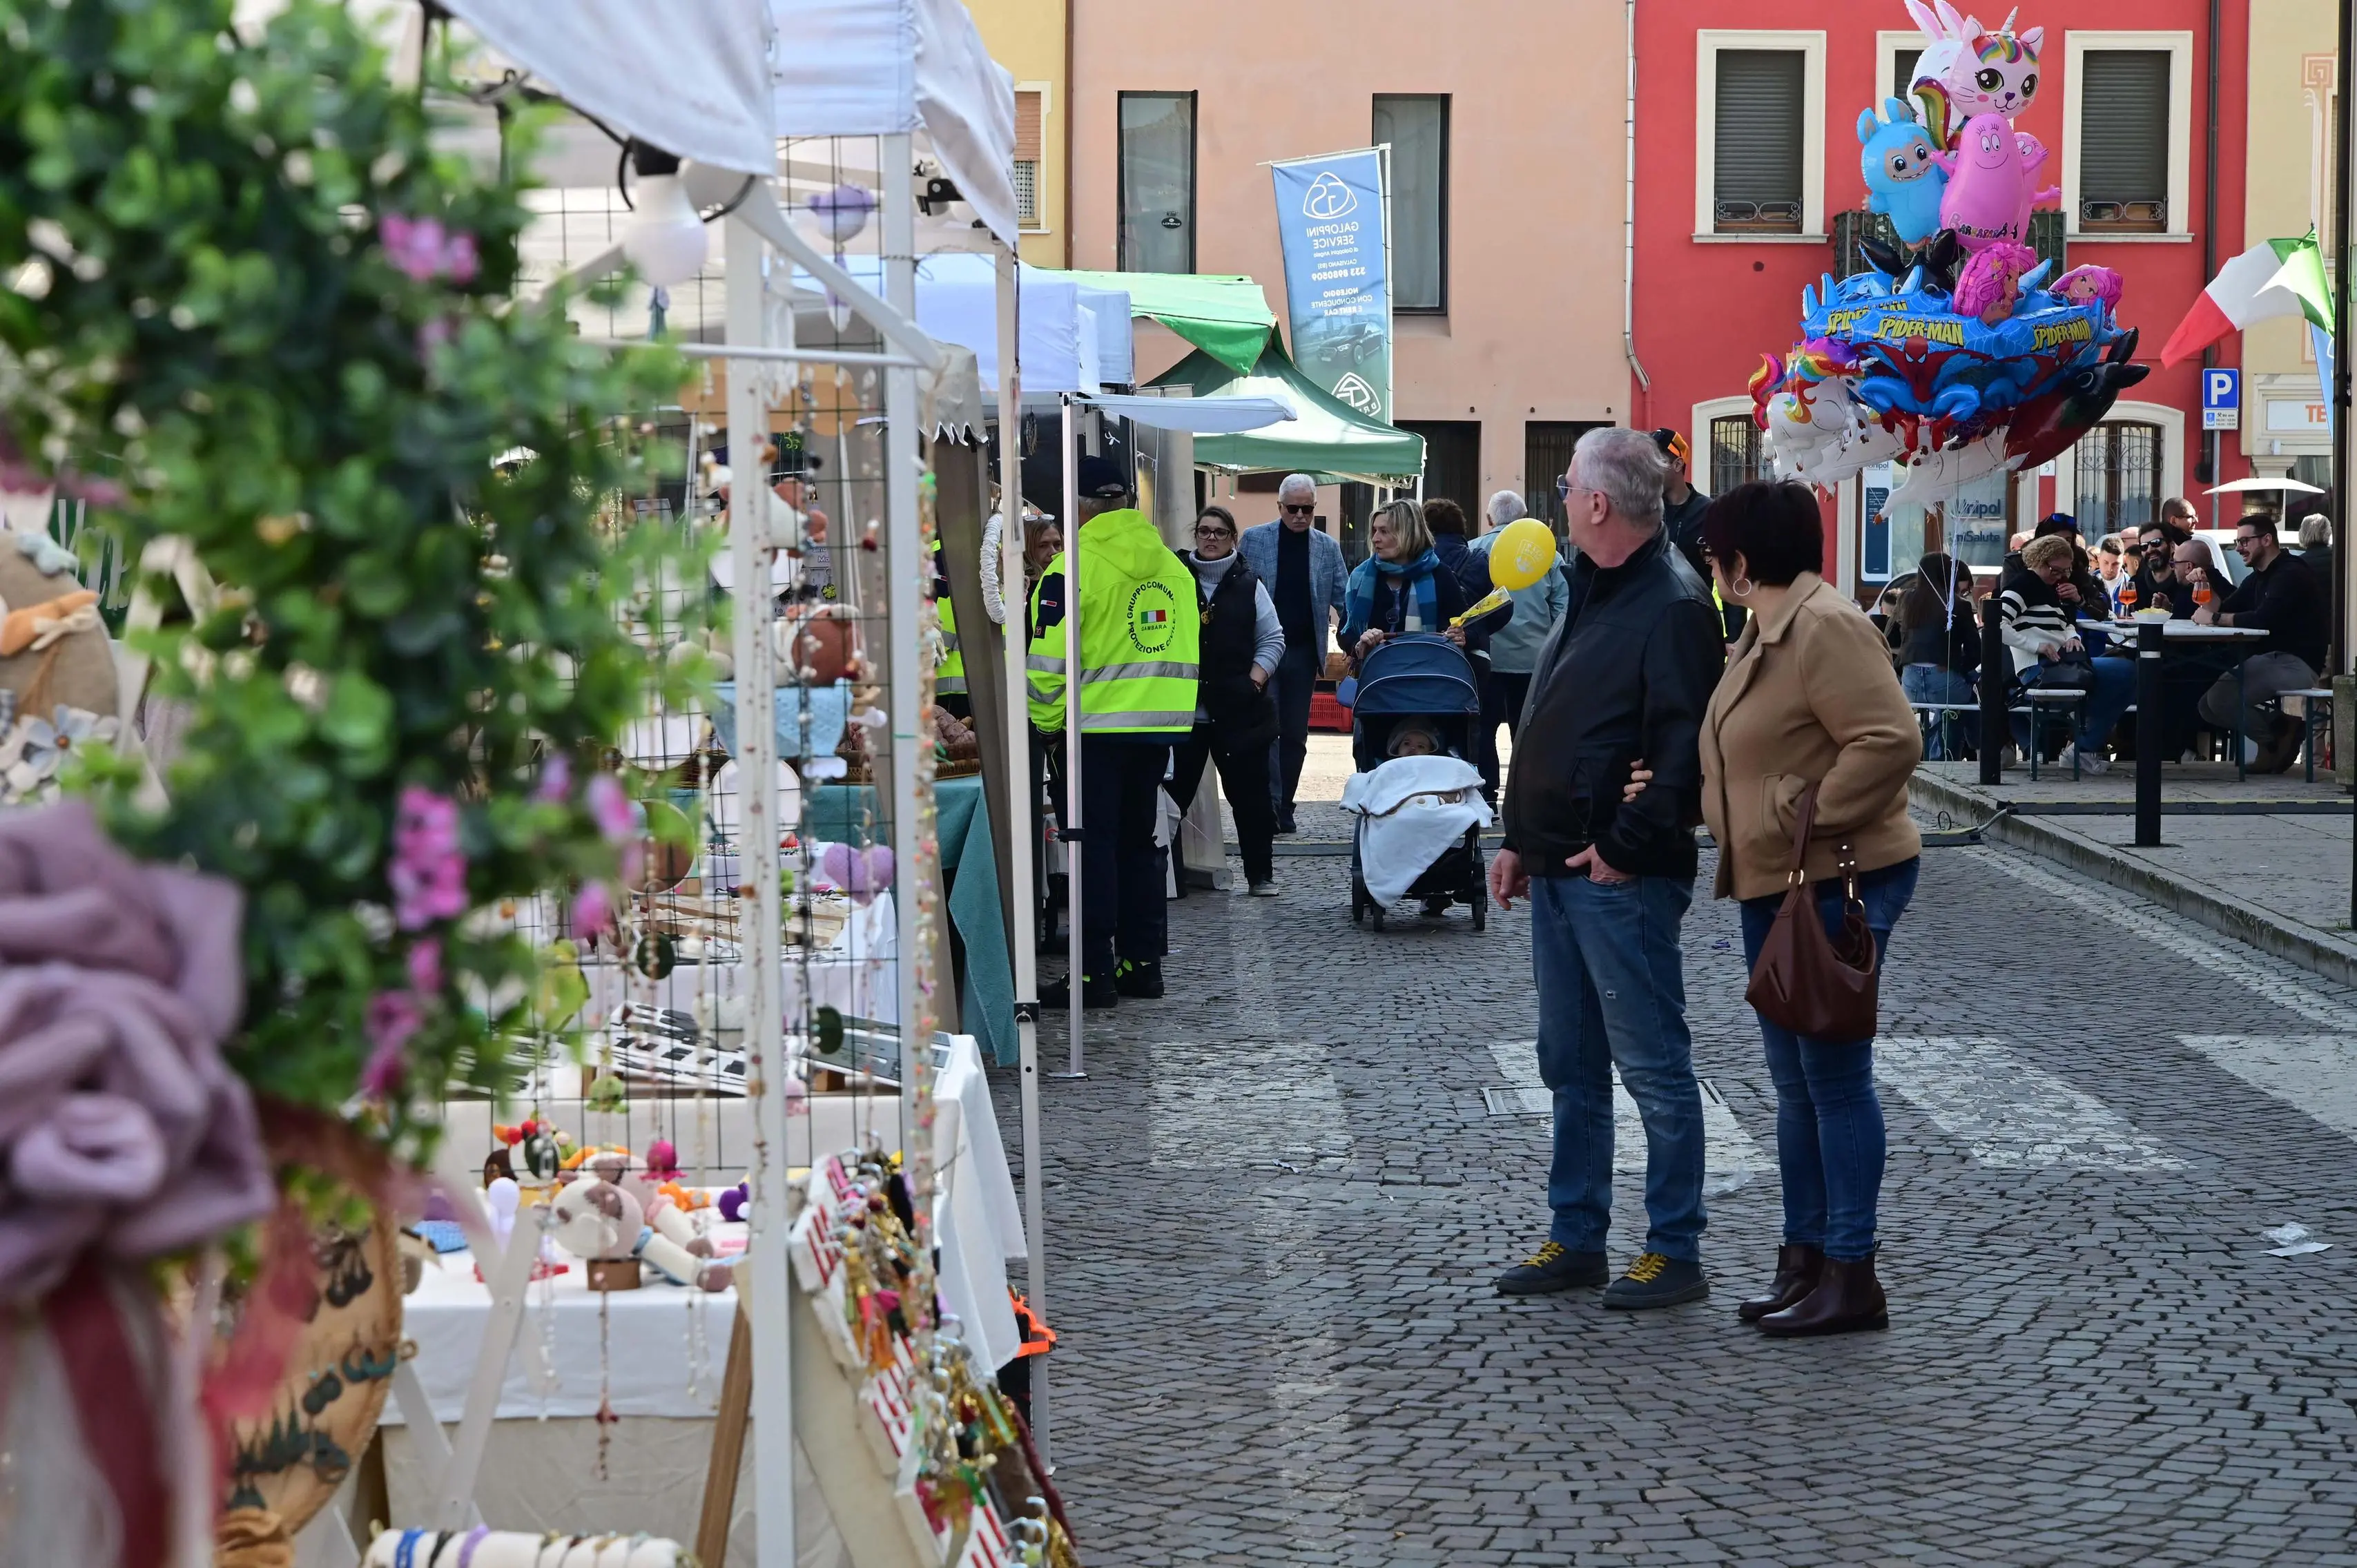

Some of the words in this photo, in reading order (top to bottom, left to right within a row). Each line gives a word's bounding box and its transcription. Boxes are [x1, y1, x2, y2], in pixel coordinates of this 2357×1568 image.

[1872, 318, 1964, 347] SPIDER-MAN
[2030, 319, 2091, 351] SPIDER-MAN
[2211, 373, 2233, 405] P
[1867, 462, 1889, 470] nipol
[2044, 463, 2050, 472] 5
[1127, 584, 1146, 619] GRUPPO
[1127, 621, 1166, 654] PROTEZIONE
